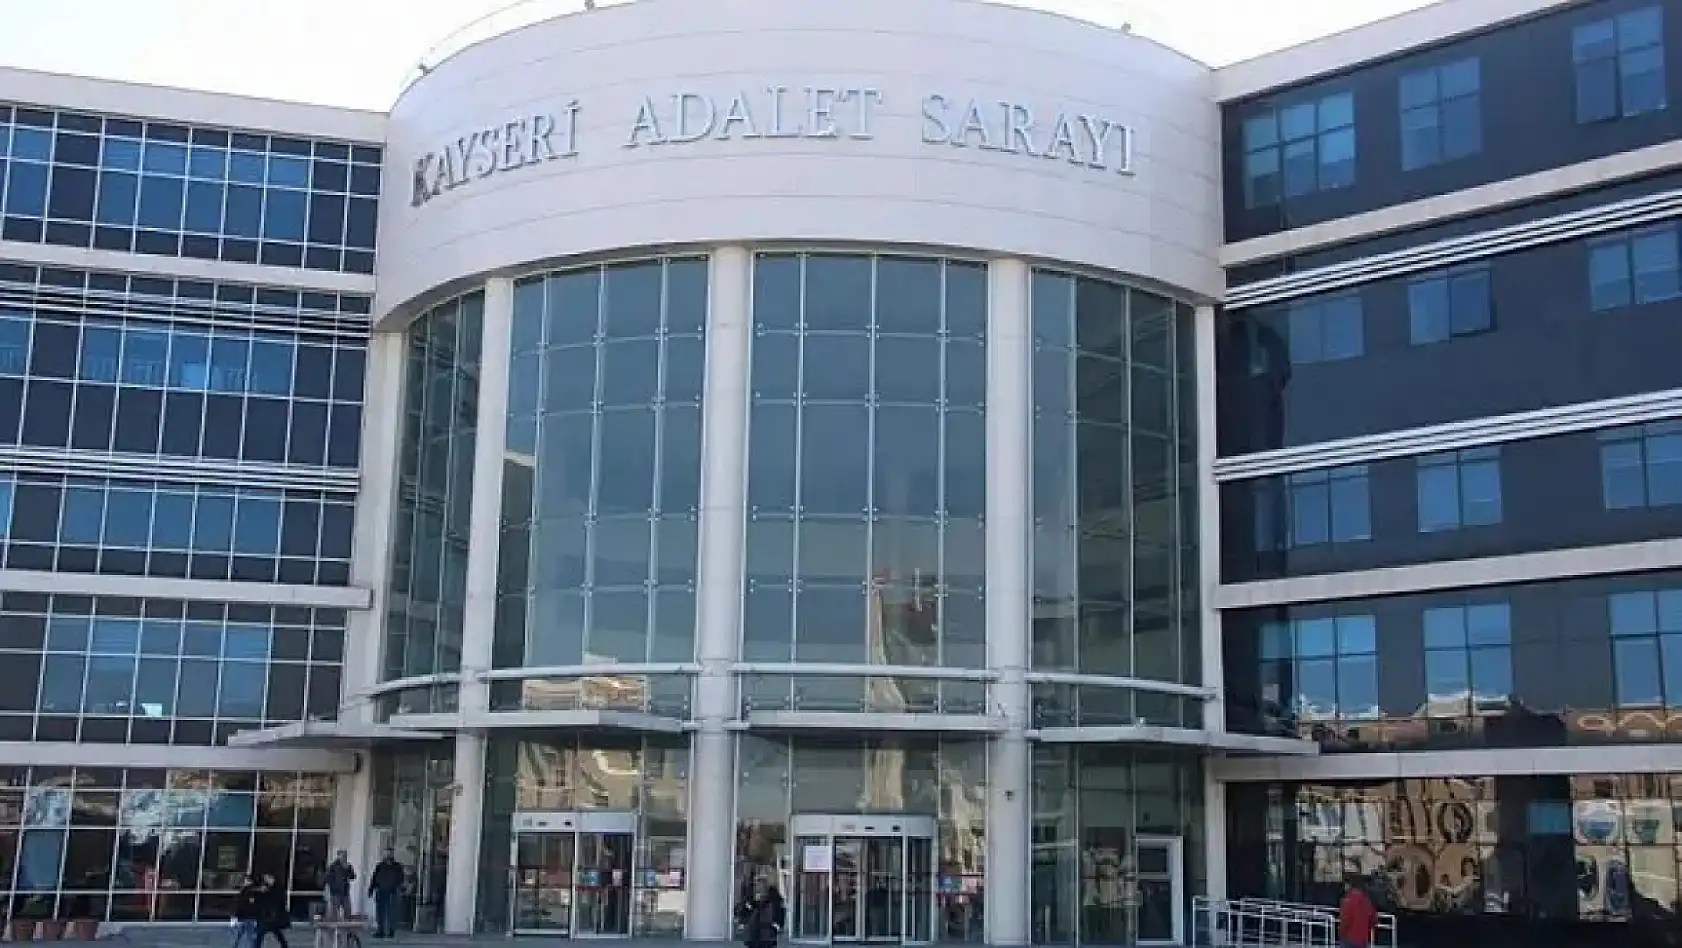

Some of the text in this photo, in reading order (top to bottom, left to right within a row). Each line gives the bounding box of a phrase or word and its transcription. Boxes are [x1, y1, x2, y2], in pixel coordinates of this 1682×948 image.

[410, 84, 1136, 207] KAYSERİ ADALET SARAYI
